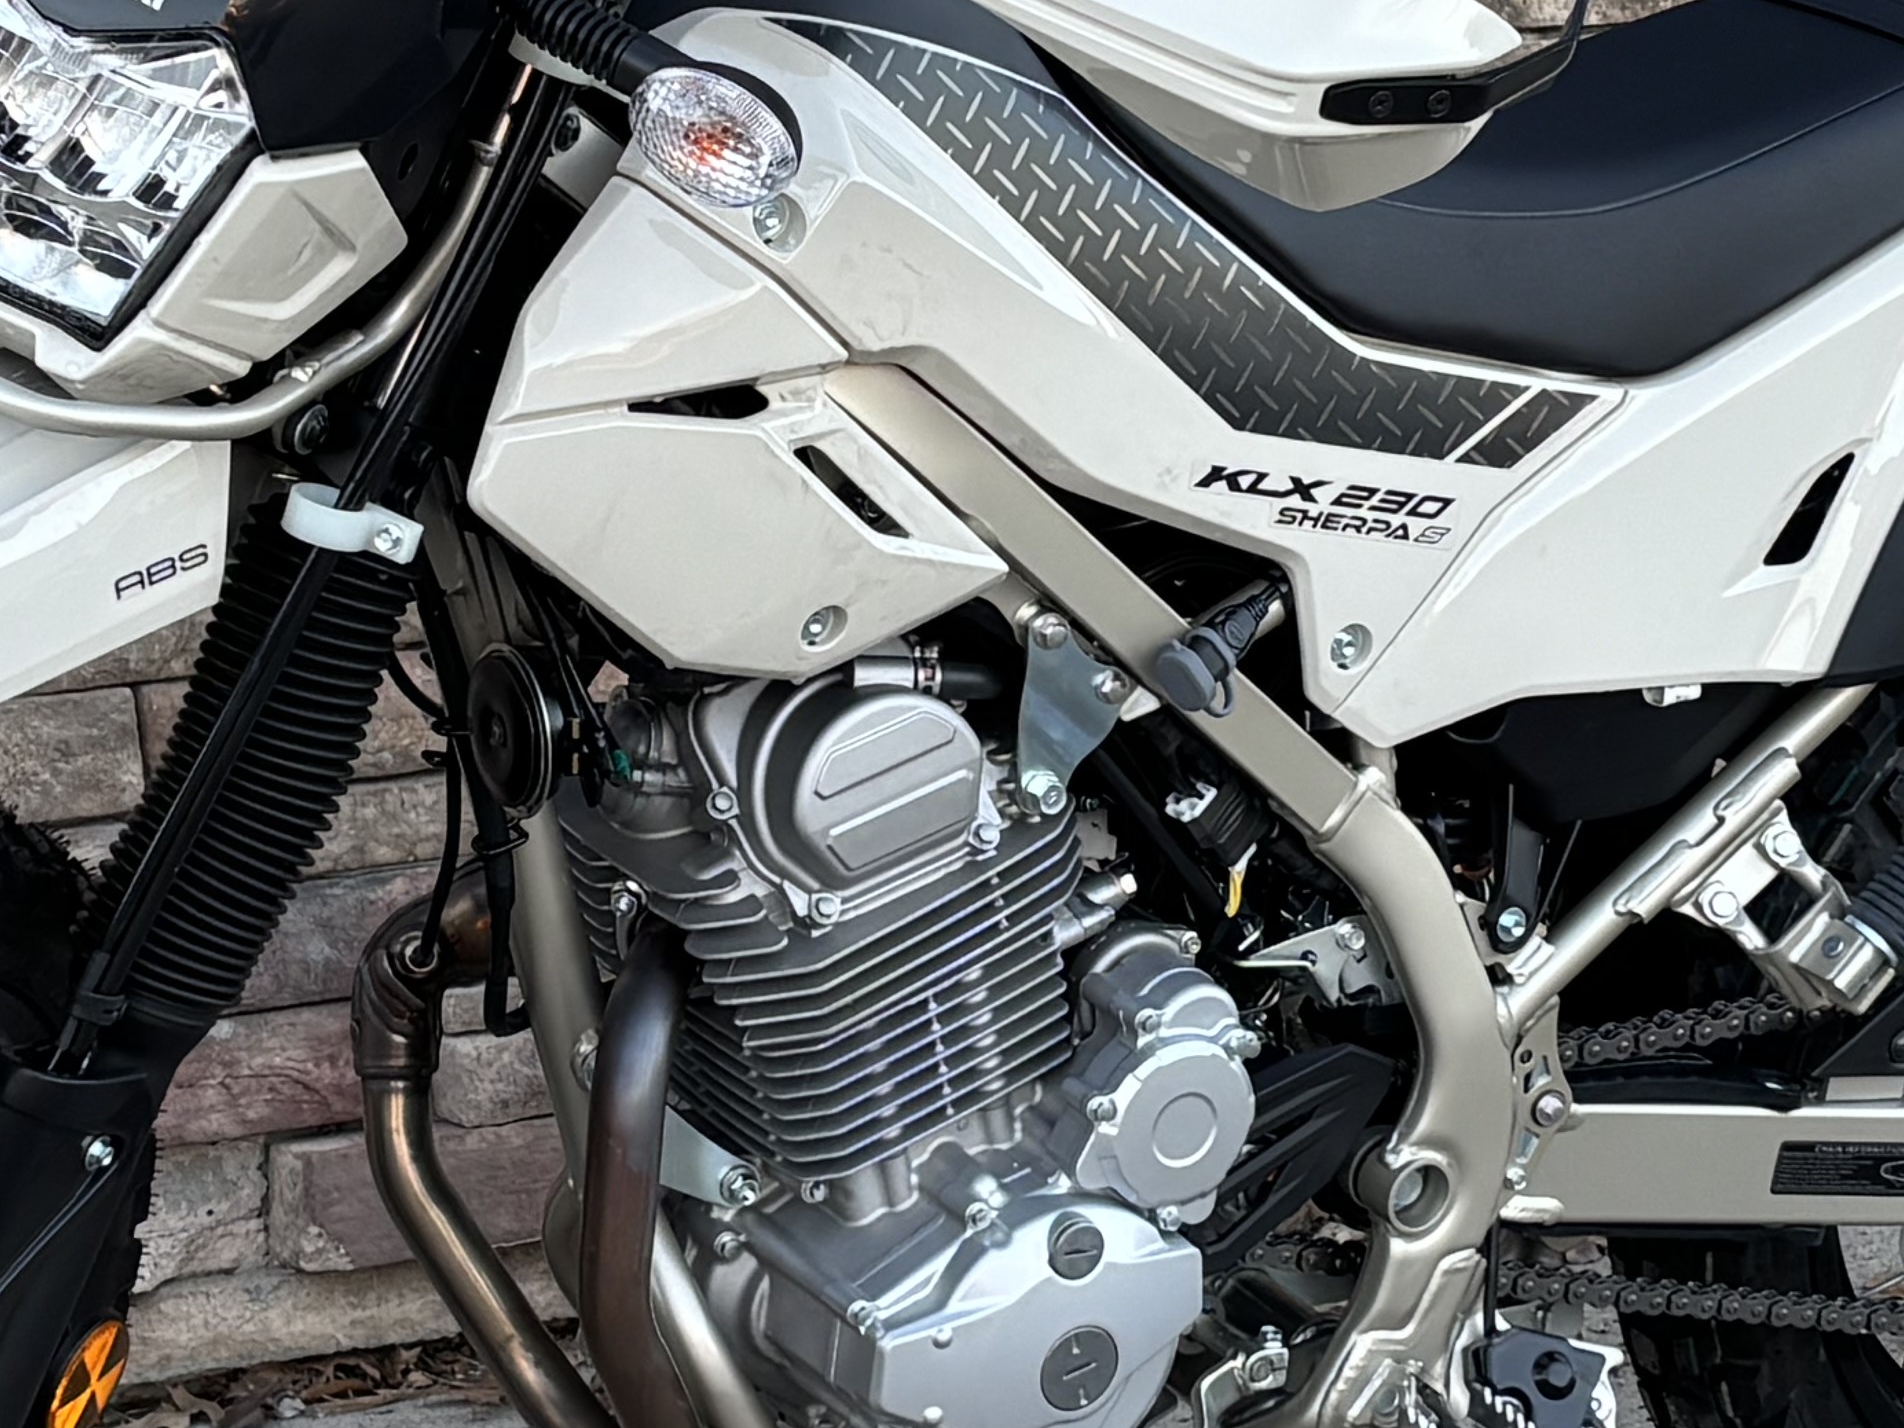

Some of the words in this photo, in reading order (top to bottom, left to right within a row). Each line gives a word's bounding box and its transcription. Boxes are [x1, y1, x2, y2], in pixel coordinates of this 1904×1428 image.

[1194, 465, 1333, 503] KLX
[1329, 485, 1456, 520] 230
[1273, 507, 1410, 541] SHERPA
[114, 543, 208, 600] ABS
